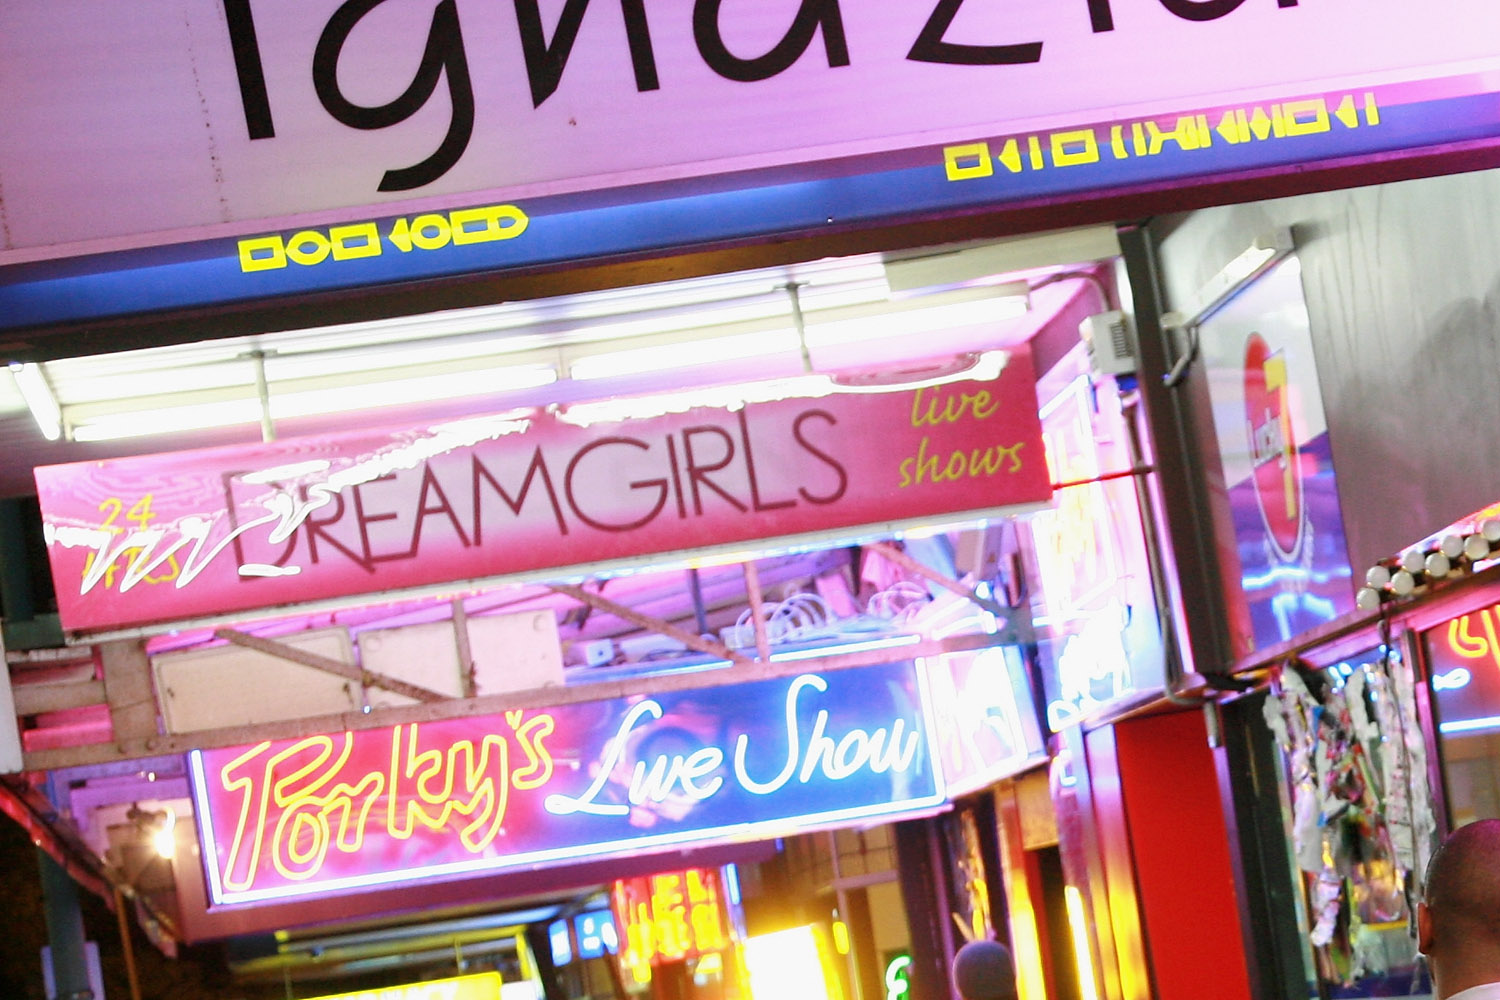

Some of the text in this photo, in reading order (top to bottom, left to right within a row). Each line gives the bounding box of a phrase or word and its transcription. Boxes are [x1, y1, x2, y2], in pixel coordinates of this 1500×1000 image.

[911, 386, 999, 429] live
[898, 435, 1024, 489] shows
[97, 493, 157, 535] 24
[221, 410, 847, 581] DREAMGIRLS
[222, 710, 555, 892] Porky's
[543, 699, 725, 816] Live
[734, 673, 920, 795] Show
